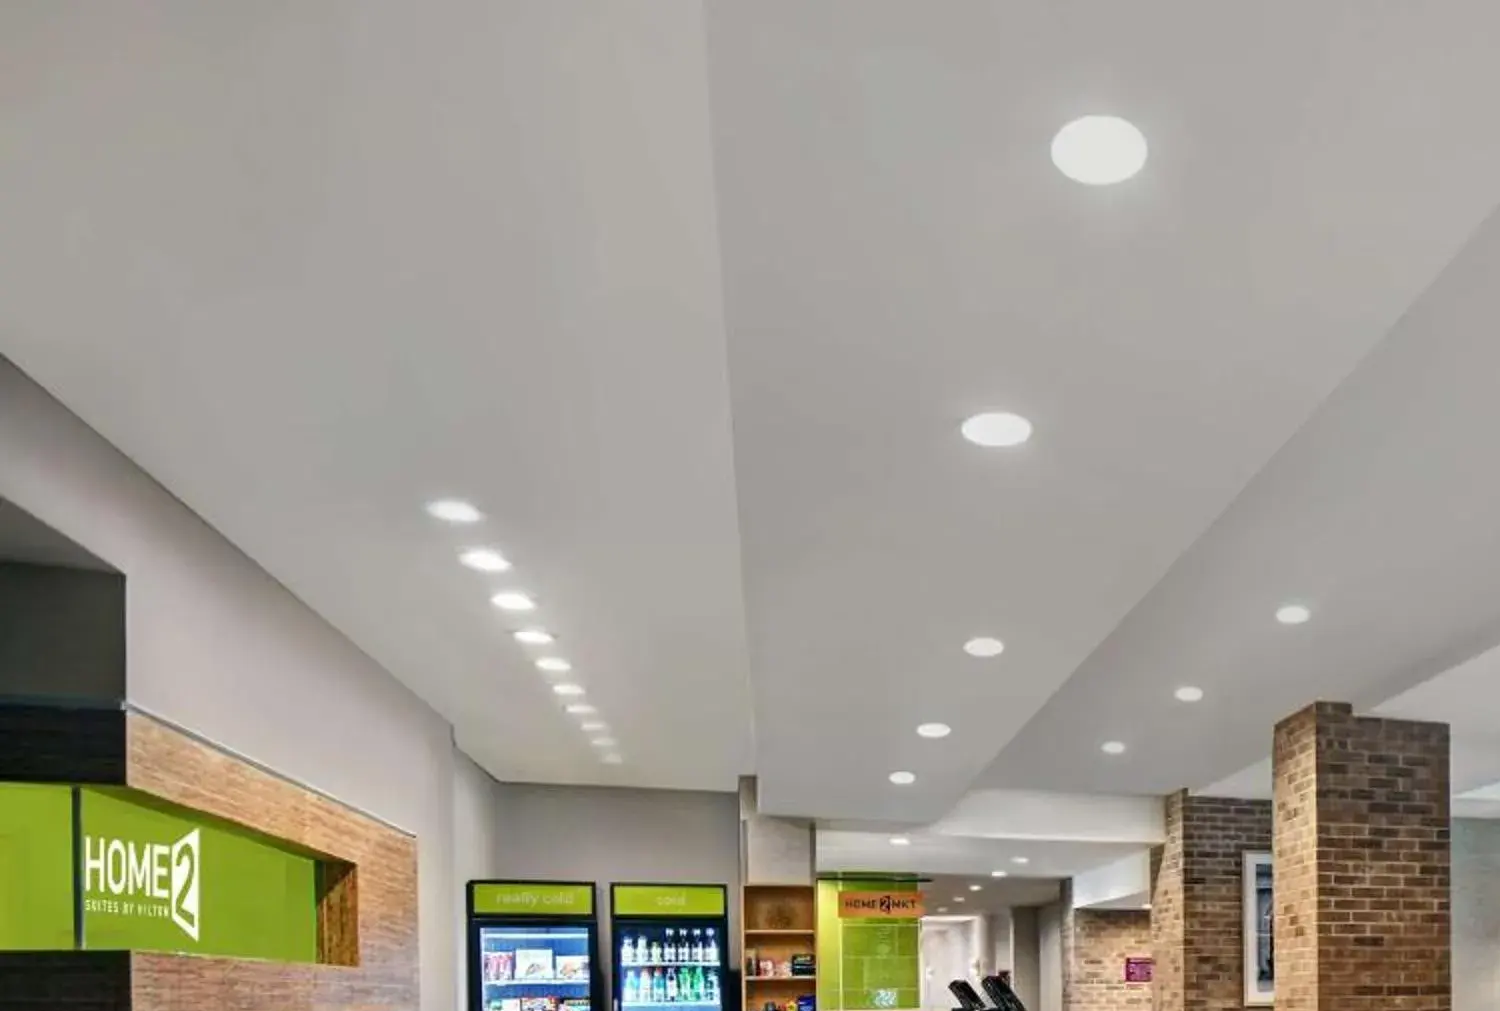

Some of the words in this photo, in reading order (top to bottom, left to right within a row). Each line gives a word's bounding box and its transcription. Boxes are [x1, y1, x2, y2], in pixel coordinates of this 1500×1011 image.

[85, 899, 119, 913] SUITES
[496, 891, 539, 908] really
[542, 891, 574, 906] cold
